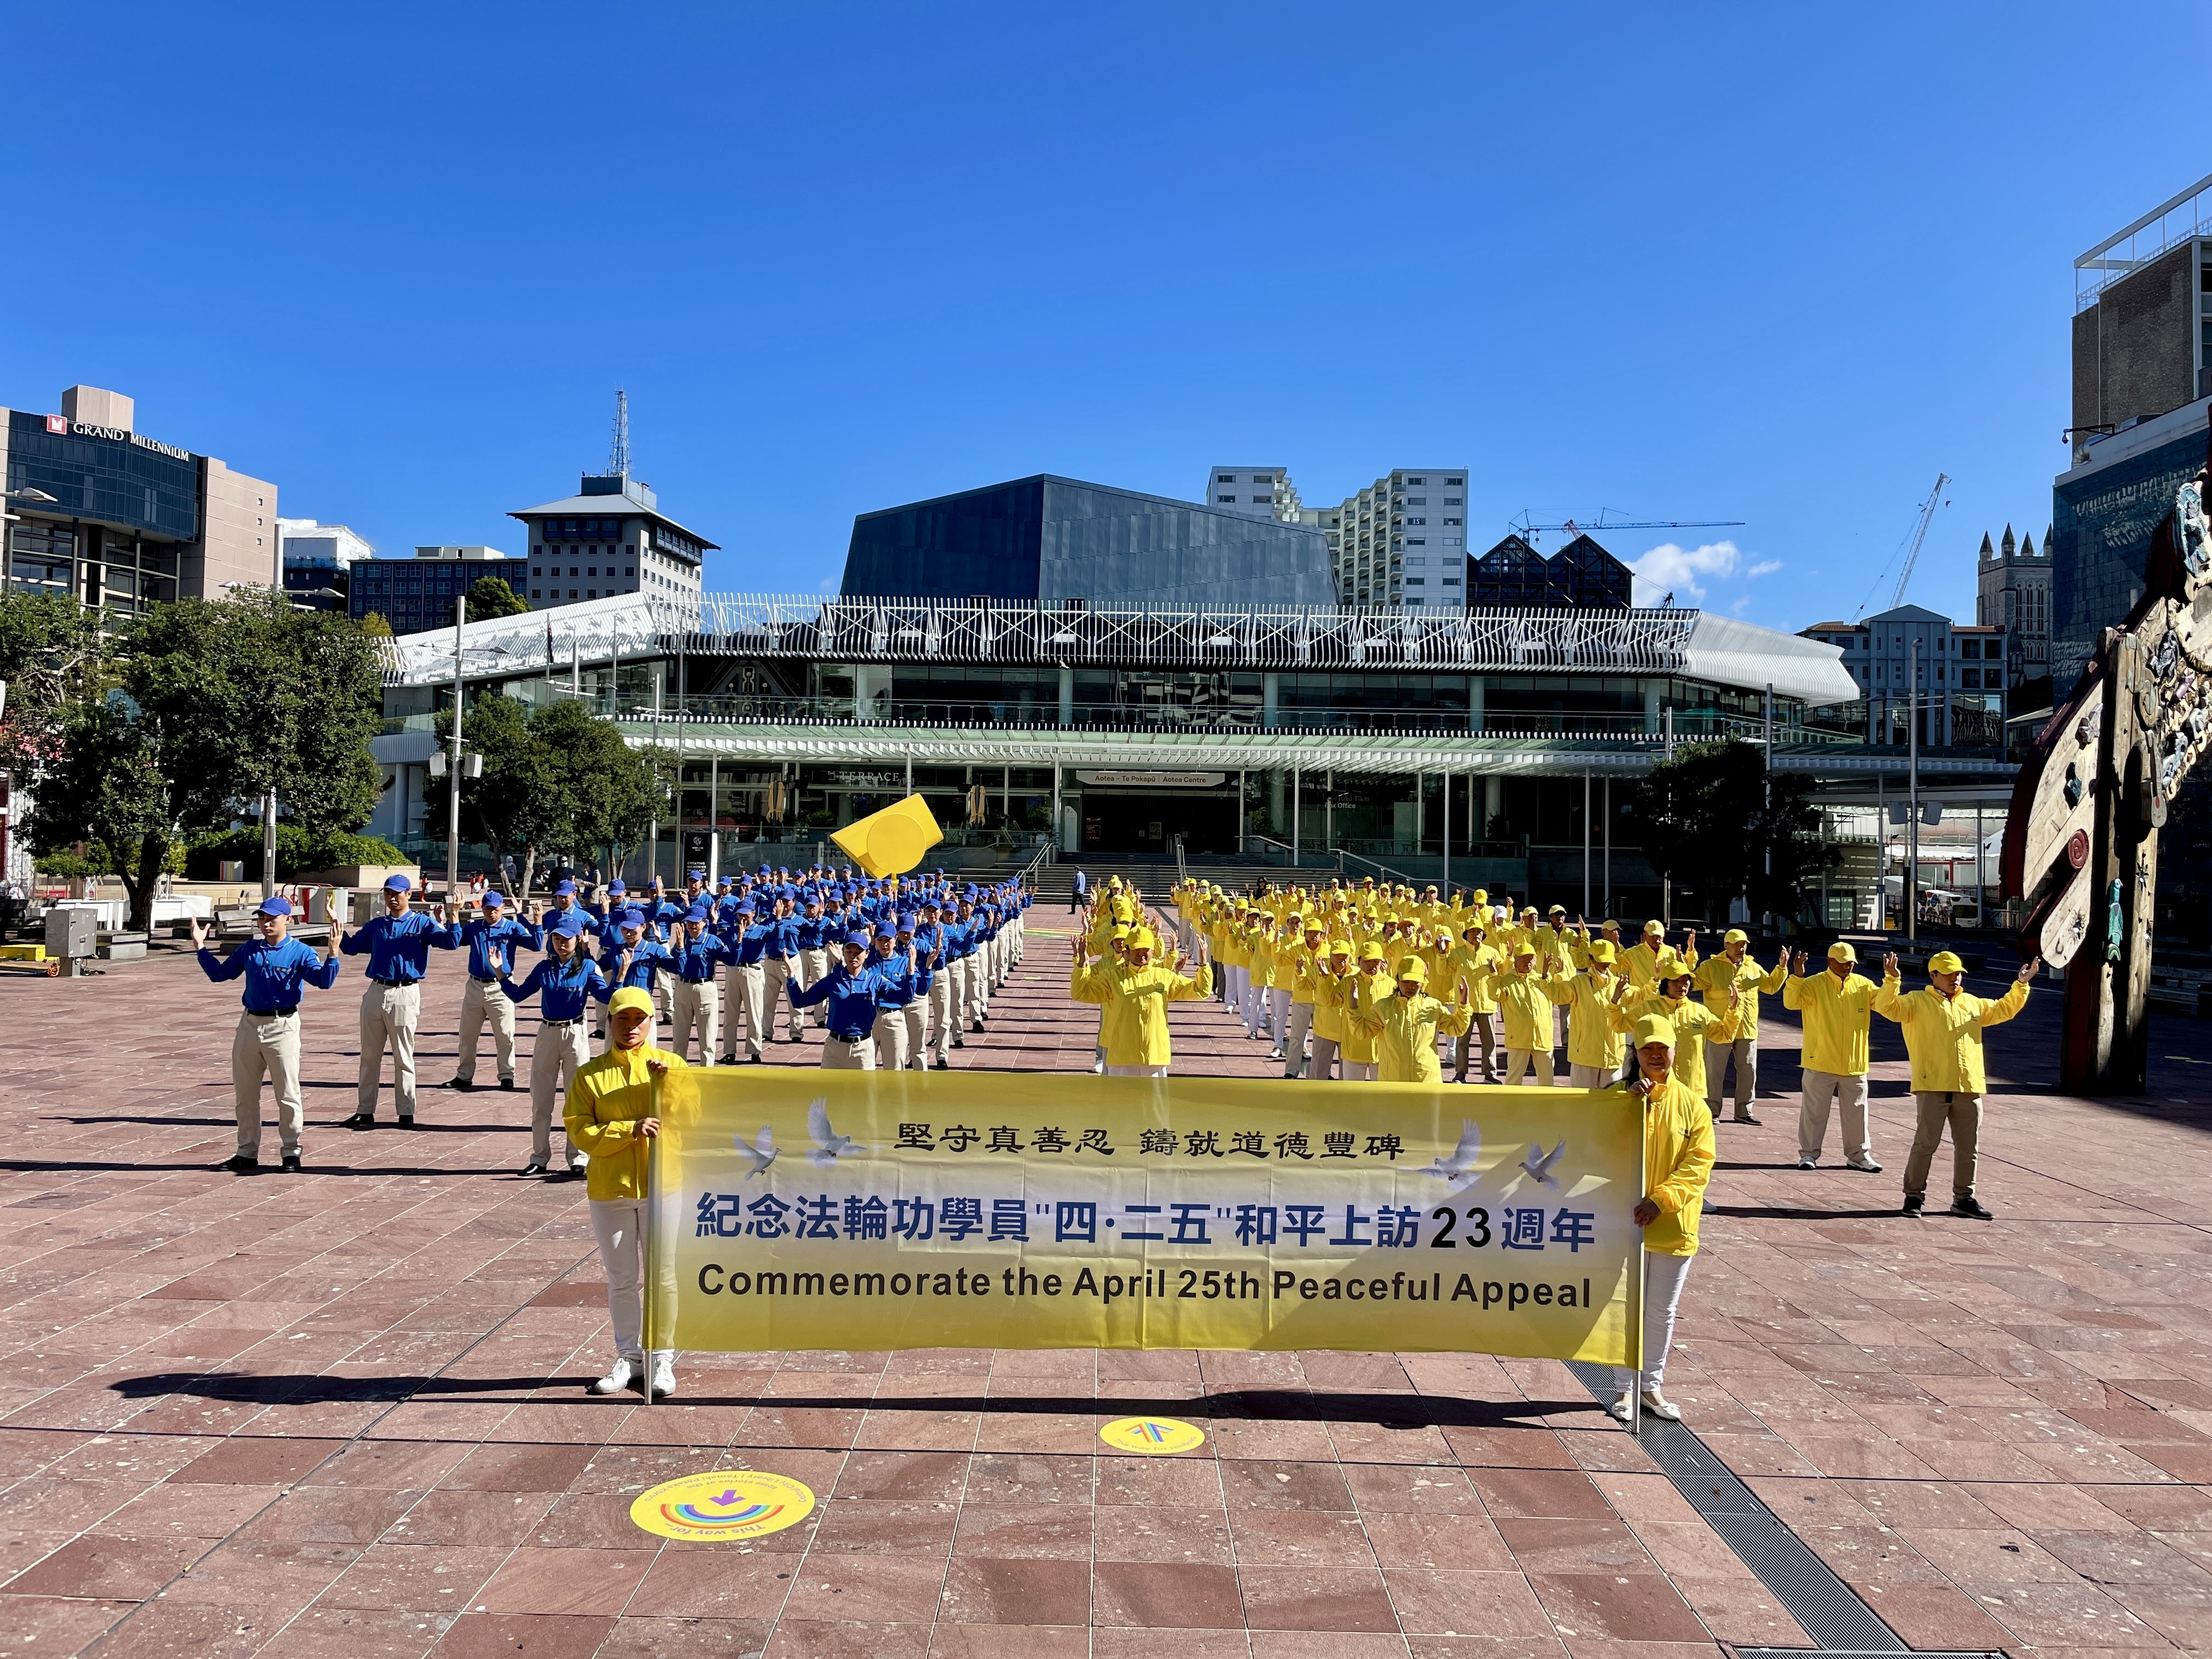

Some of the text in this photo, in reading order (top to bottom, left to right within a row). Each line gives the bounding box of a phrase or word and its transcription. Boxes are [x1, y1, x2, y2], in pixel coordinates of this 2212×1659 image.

[73, 422, 189, 462] GRAND MILLENNIUM
[839, 771, 900, 782] TERRACE
[808, 847, 849, 857] TERR
[894, 1122, 1405, 1160] 堅守真善忍 鑄就道德豐碑
[698, 1263, 1590, 1311] Commemorate the April 25th Peaceful Appeal
[747, 1474, 780, 1483] Library
[755, 1481, 778, 1489] some
[731, 1524, 766, 1534] This
